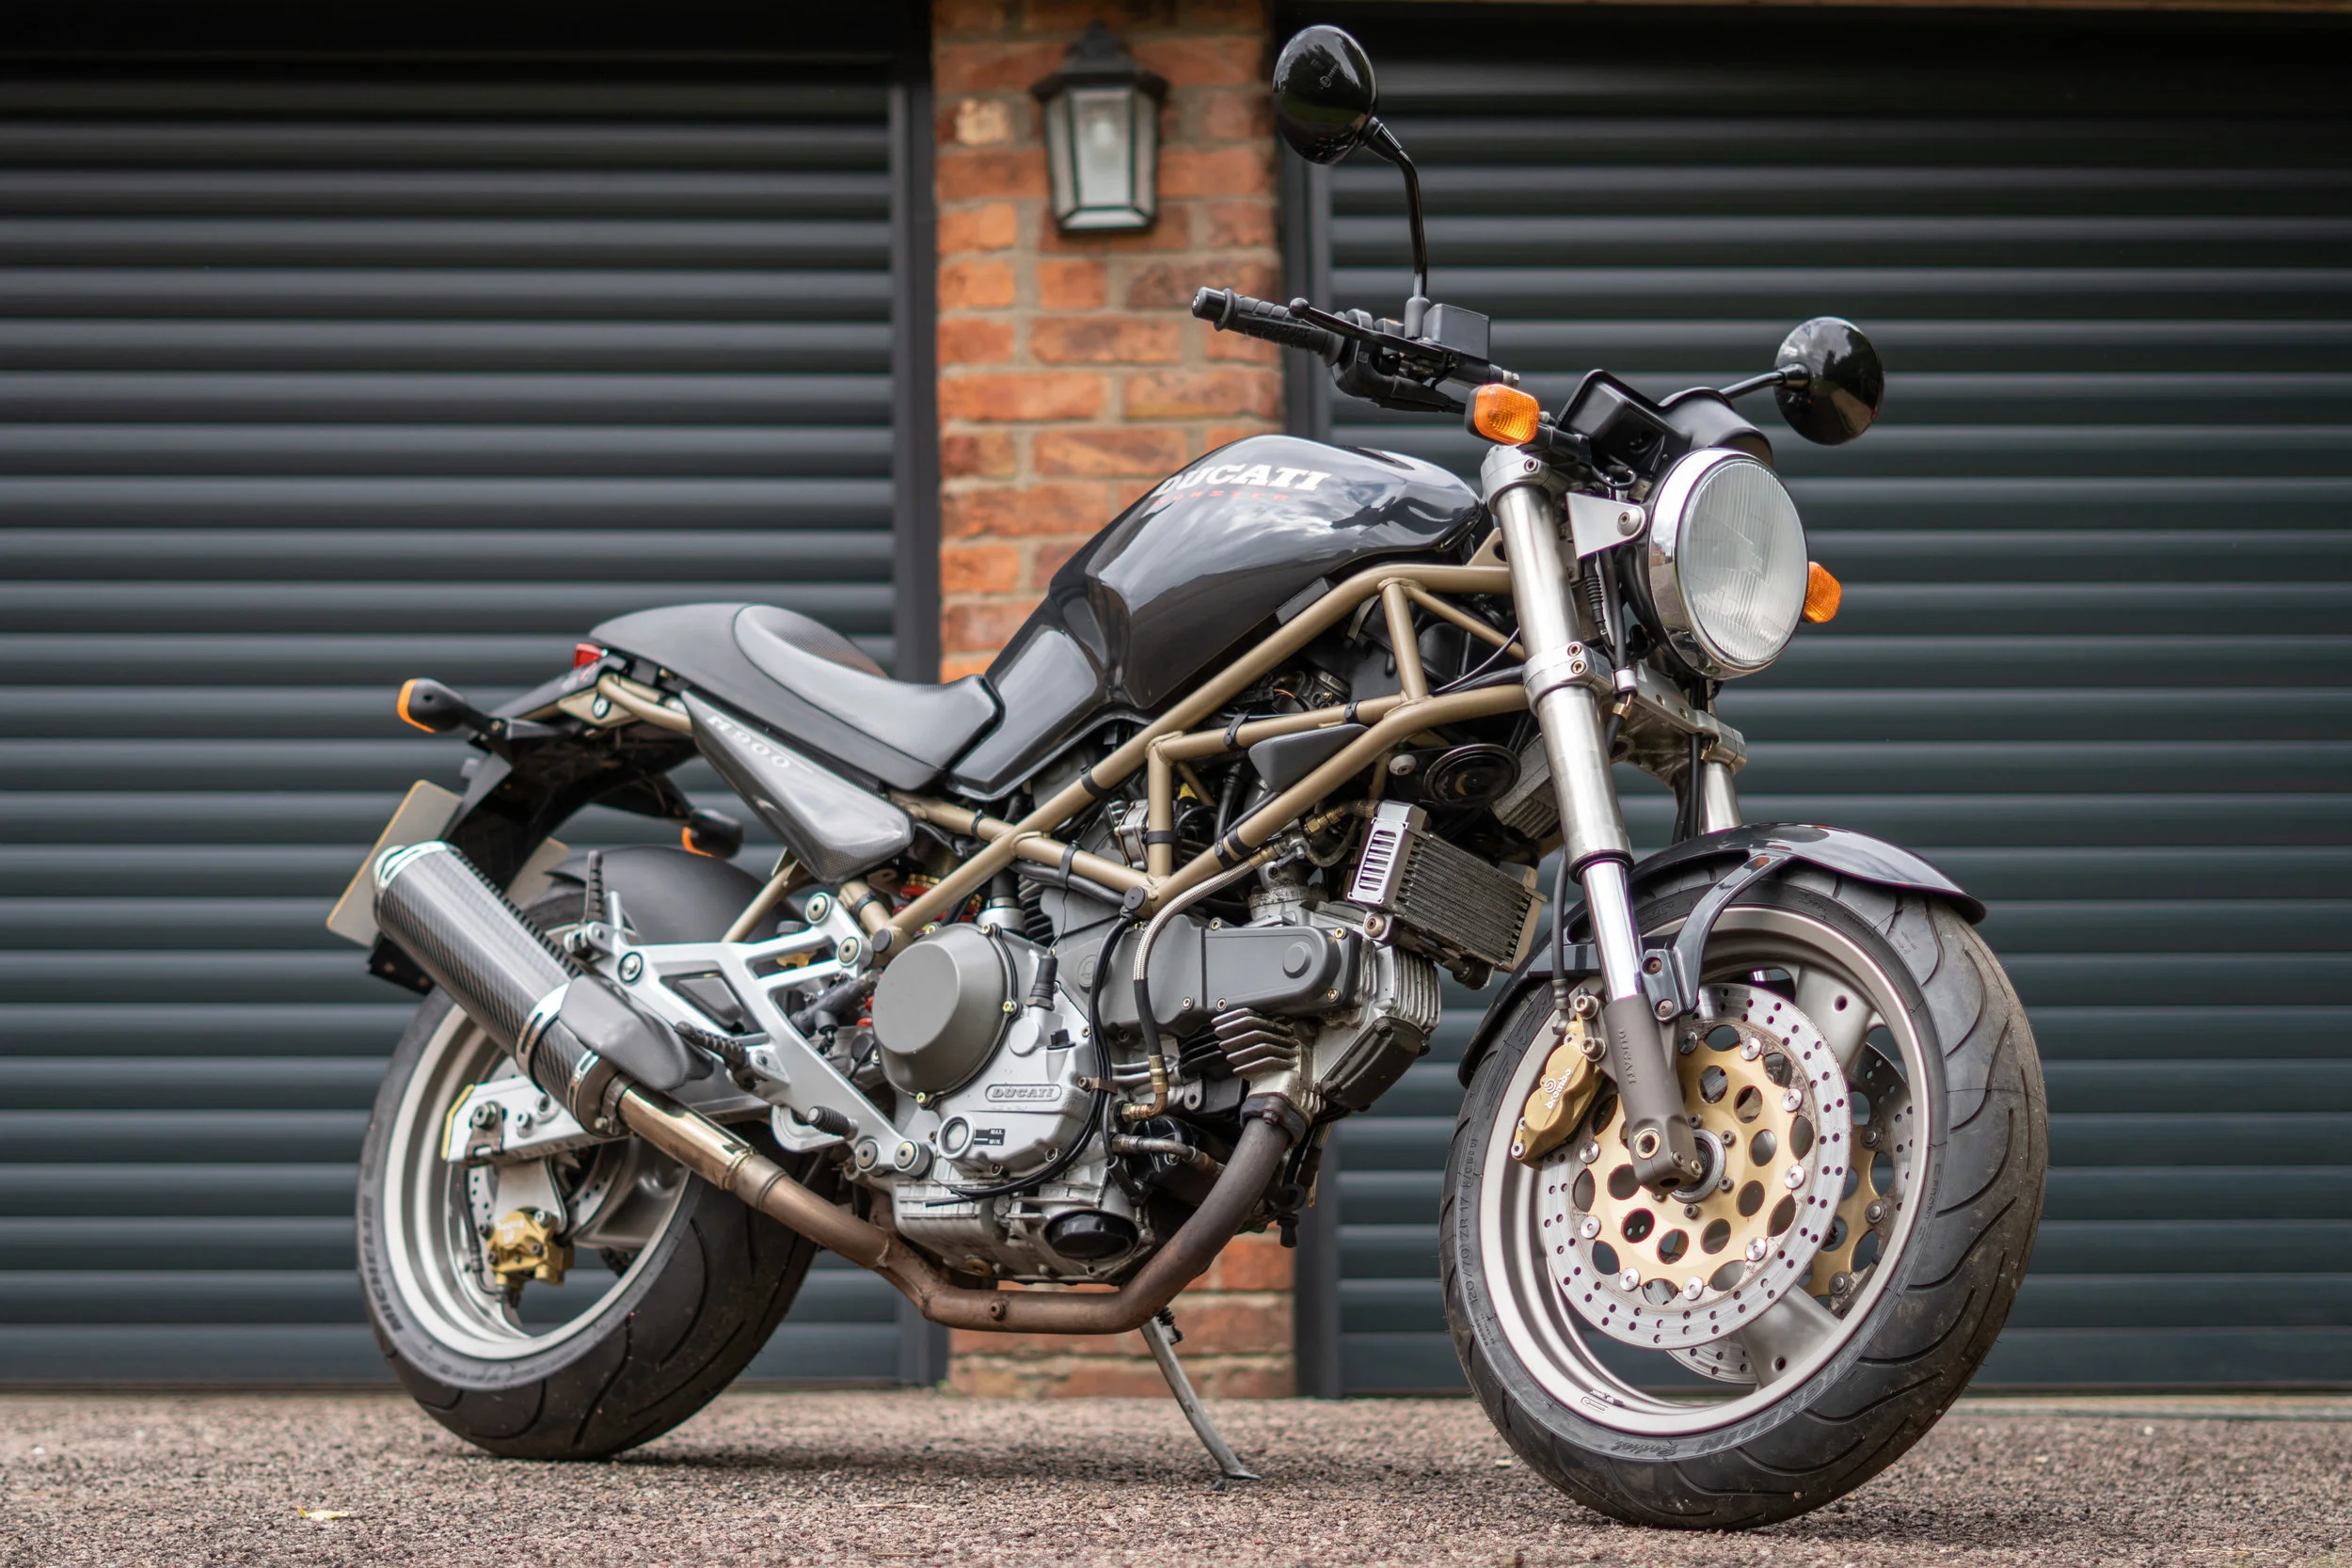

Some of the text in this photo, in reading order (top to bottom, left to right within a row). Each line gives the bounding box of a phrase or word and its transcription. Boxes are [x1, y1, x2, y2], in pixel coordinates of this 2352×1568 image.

[1149, 463, 1332, 498] DUCATI
[1618, 1028, 1637, 1085] DUCATI
[992, 1087, 1054, 1099] DUCATI
[1545, 1069, 1572, 1110] brembo
